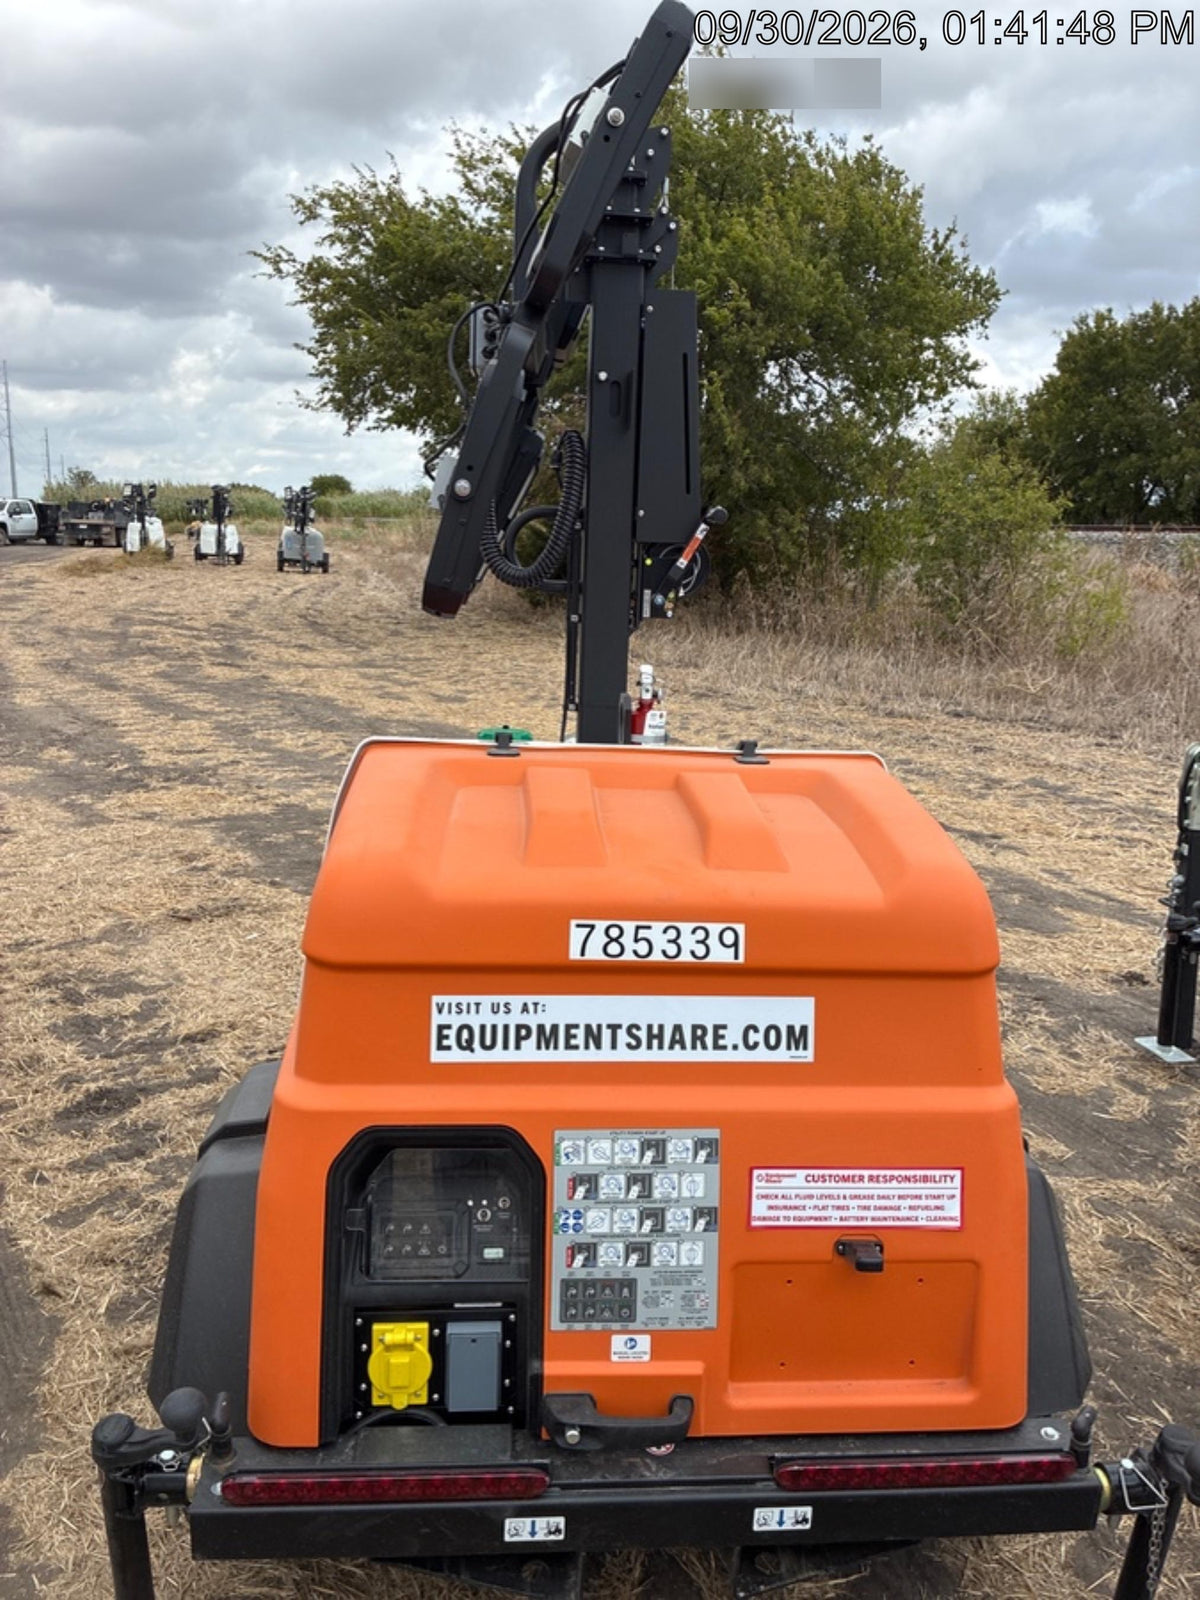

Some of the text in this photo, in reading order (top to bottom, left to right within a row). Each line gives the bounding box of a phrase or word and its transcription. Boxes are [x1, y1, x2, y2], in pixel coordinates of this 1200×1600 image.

[574, 922, 741, 961] 785339
[435, 1002, 547, 1015] VISIT US AT:
[435, 1023, 809, 1053] EQUIPMENTSHARE.COM
[804, 1174, 956, 1184] CUSTOMER RESPONSIBILITY
